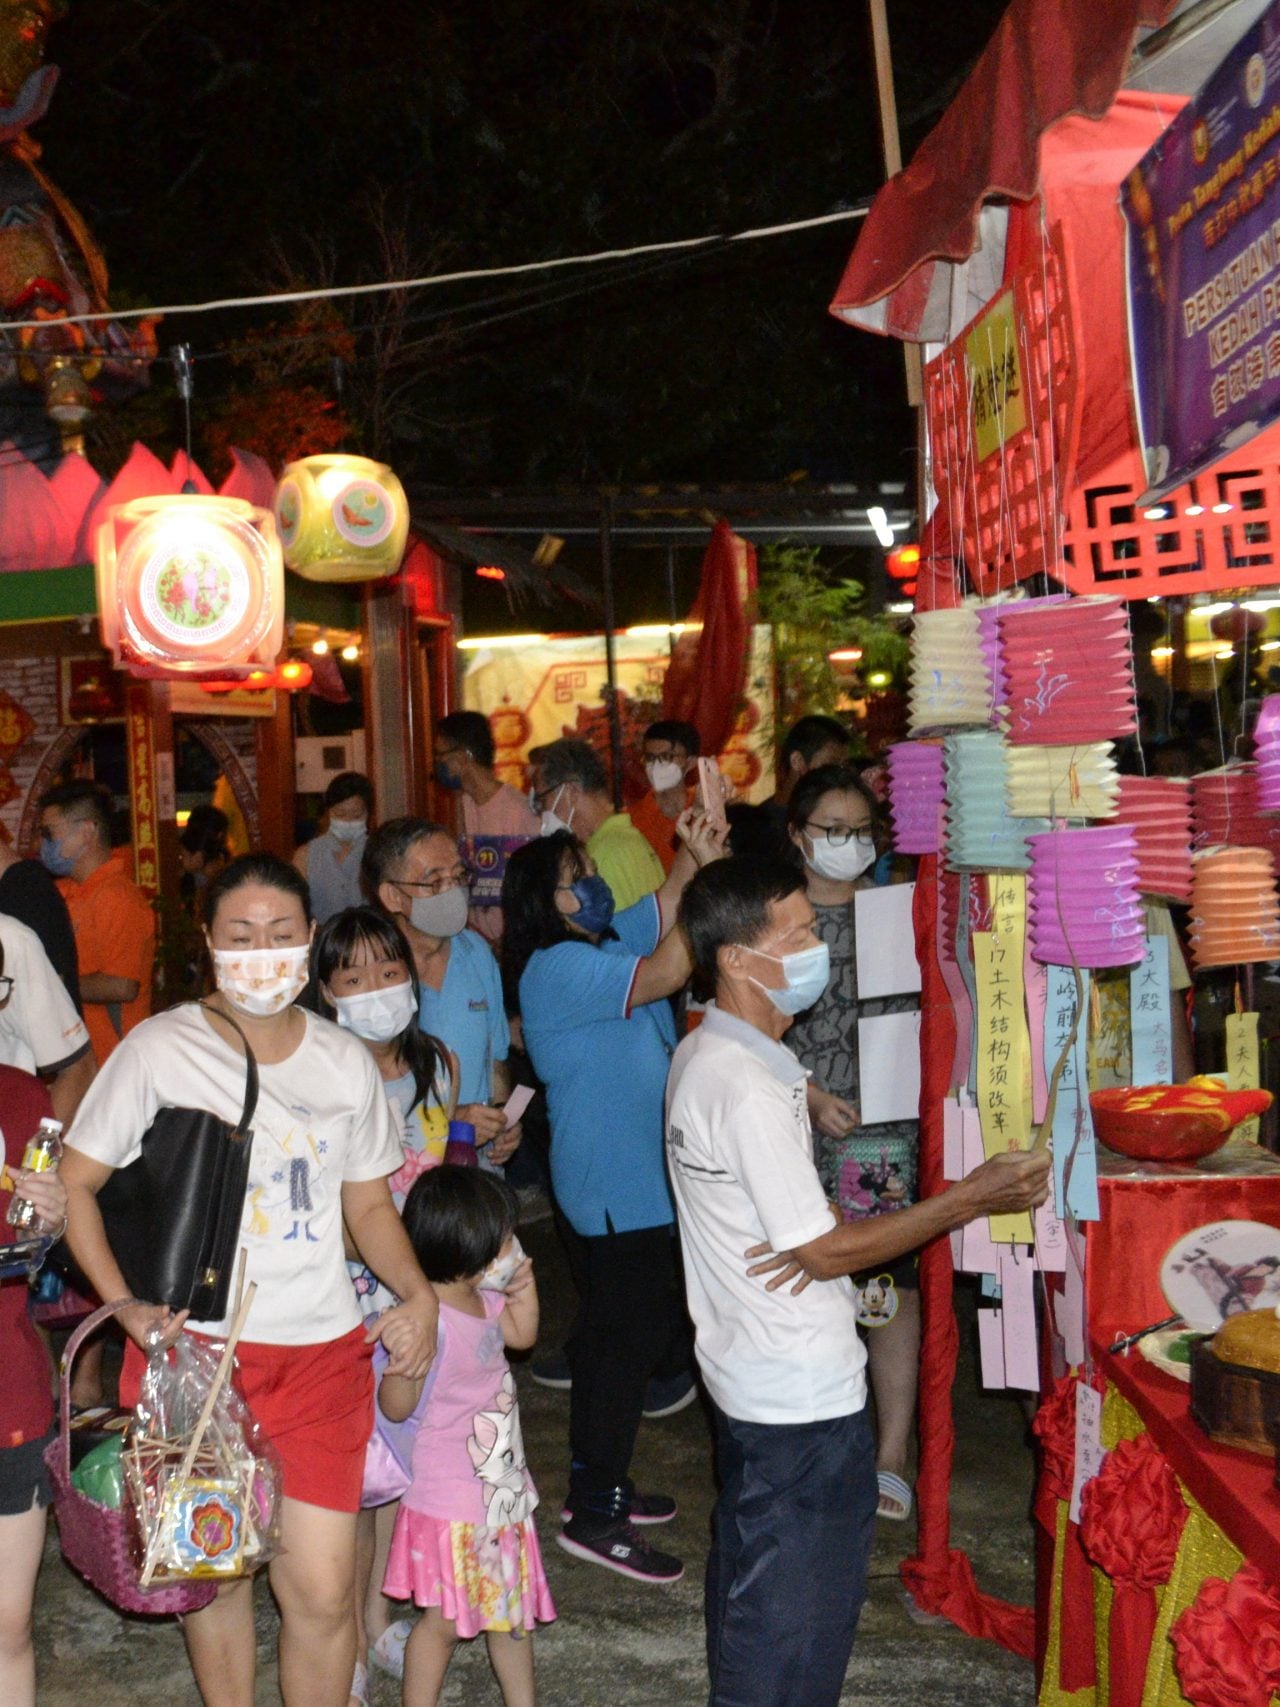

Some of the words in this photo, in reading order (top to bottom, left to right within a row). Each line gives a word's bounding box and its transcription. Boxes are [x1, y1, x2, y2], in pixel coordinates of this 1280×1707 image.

[1183, 230, 1273, 338] PERSATUAN
[1208, 293, 1261, 368] KEDAH
[479, 850, 495, 866] 21
